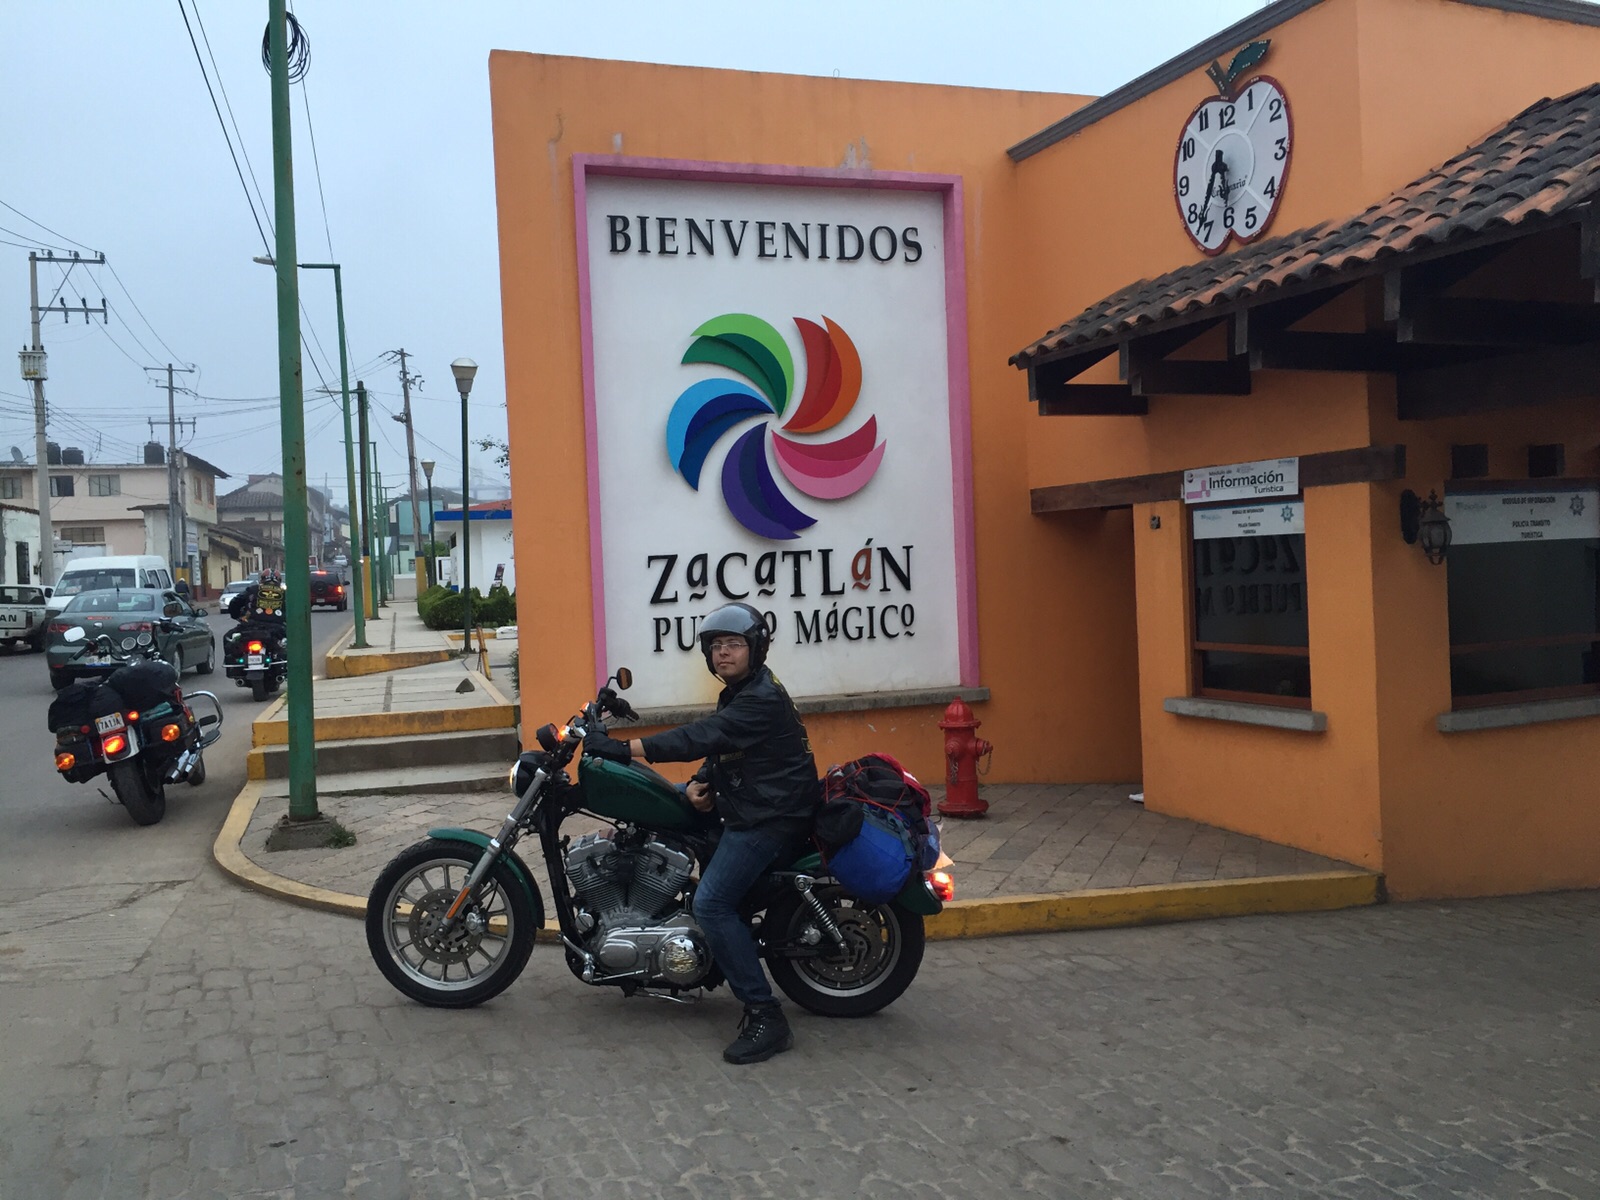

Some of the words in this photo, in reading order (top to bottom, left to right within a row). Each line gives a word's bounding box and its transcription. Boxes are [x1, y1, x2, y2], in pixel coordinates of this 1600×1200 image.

[1247, 88, 1253, 111] 1
[1269, 98, 1282, 122] 2
[1199, 108, 1209, 132] 11
[1219, 105, 1236, 130] 12
[1182, 137, 1195, 162] 10
[1274, 137, 1287, 161] 3
[1179, 176, 1190, 196] 9
[1263, 176, 1276, 199] 4
[1188, 203, 1198, 224] 8
[1223, 207, 1235, 229] 6
[1245, 206, 1257, 229] 5
[607, 214, 923, 263] BIENVENIDOS
[1203, 220, 1214, 243] 7
[1209, 470, 1284, 489] Información
